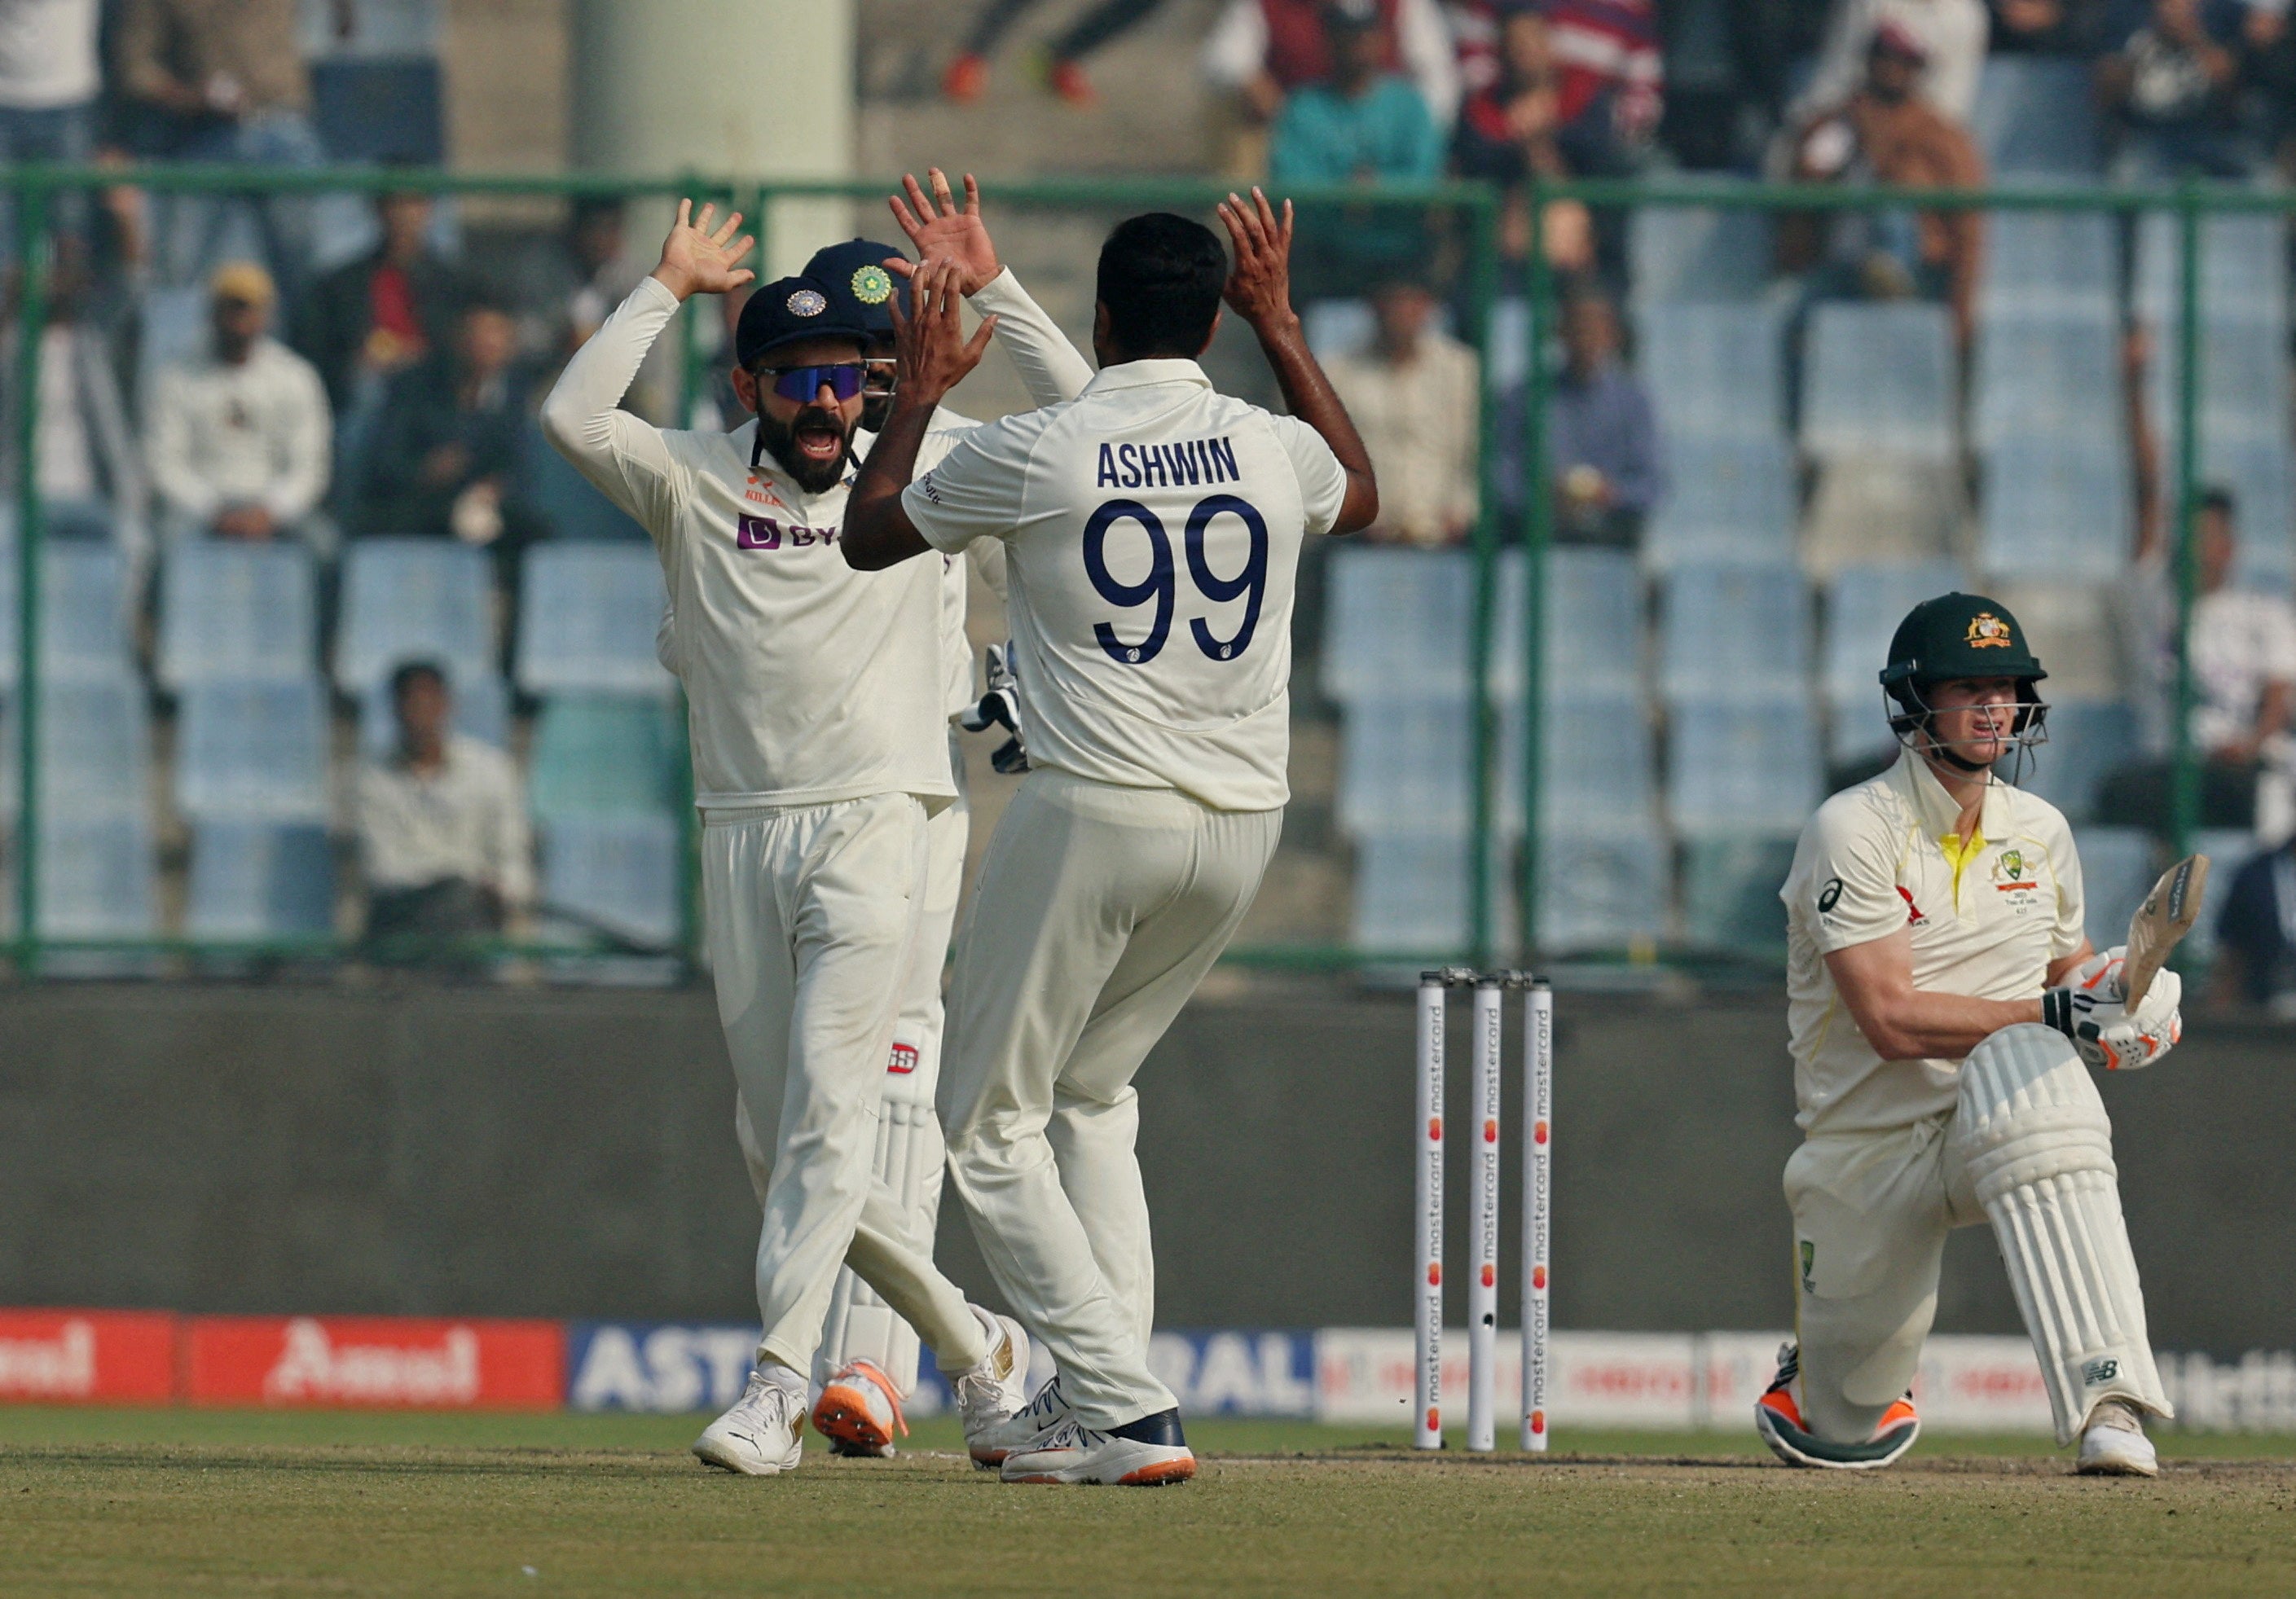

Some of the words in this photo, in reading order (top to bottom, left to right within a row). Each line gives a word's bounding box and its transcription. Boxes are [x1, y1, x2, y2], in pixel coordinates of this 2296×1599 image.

[1097, 437, 1240, 488] ASHWIN
[789, 525, 842, 547] BY
[1083, 494, 1268, 664] 99
[1428, 1004, 1441, 1114] mastercard
[1485, 1007, 1498, 1115] mastercard
[1536, 1008, 1549, 1116] mastercard
[1427, 1150, 1441, 1258] mastercard
[1482, 1152, 1495, 1259] mastercard
[1533, 1153, 1547, 1261] mastercard
[1426, 1295, 1440, 1404] mastercard
[1531, 1298, 1545, 1406] mastercard
